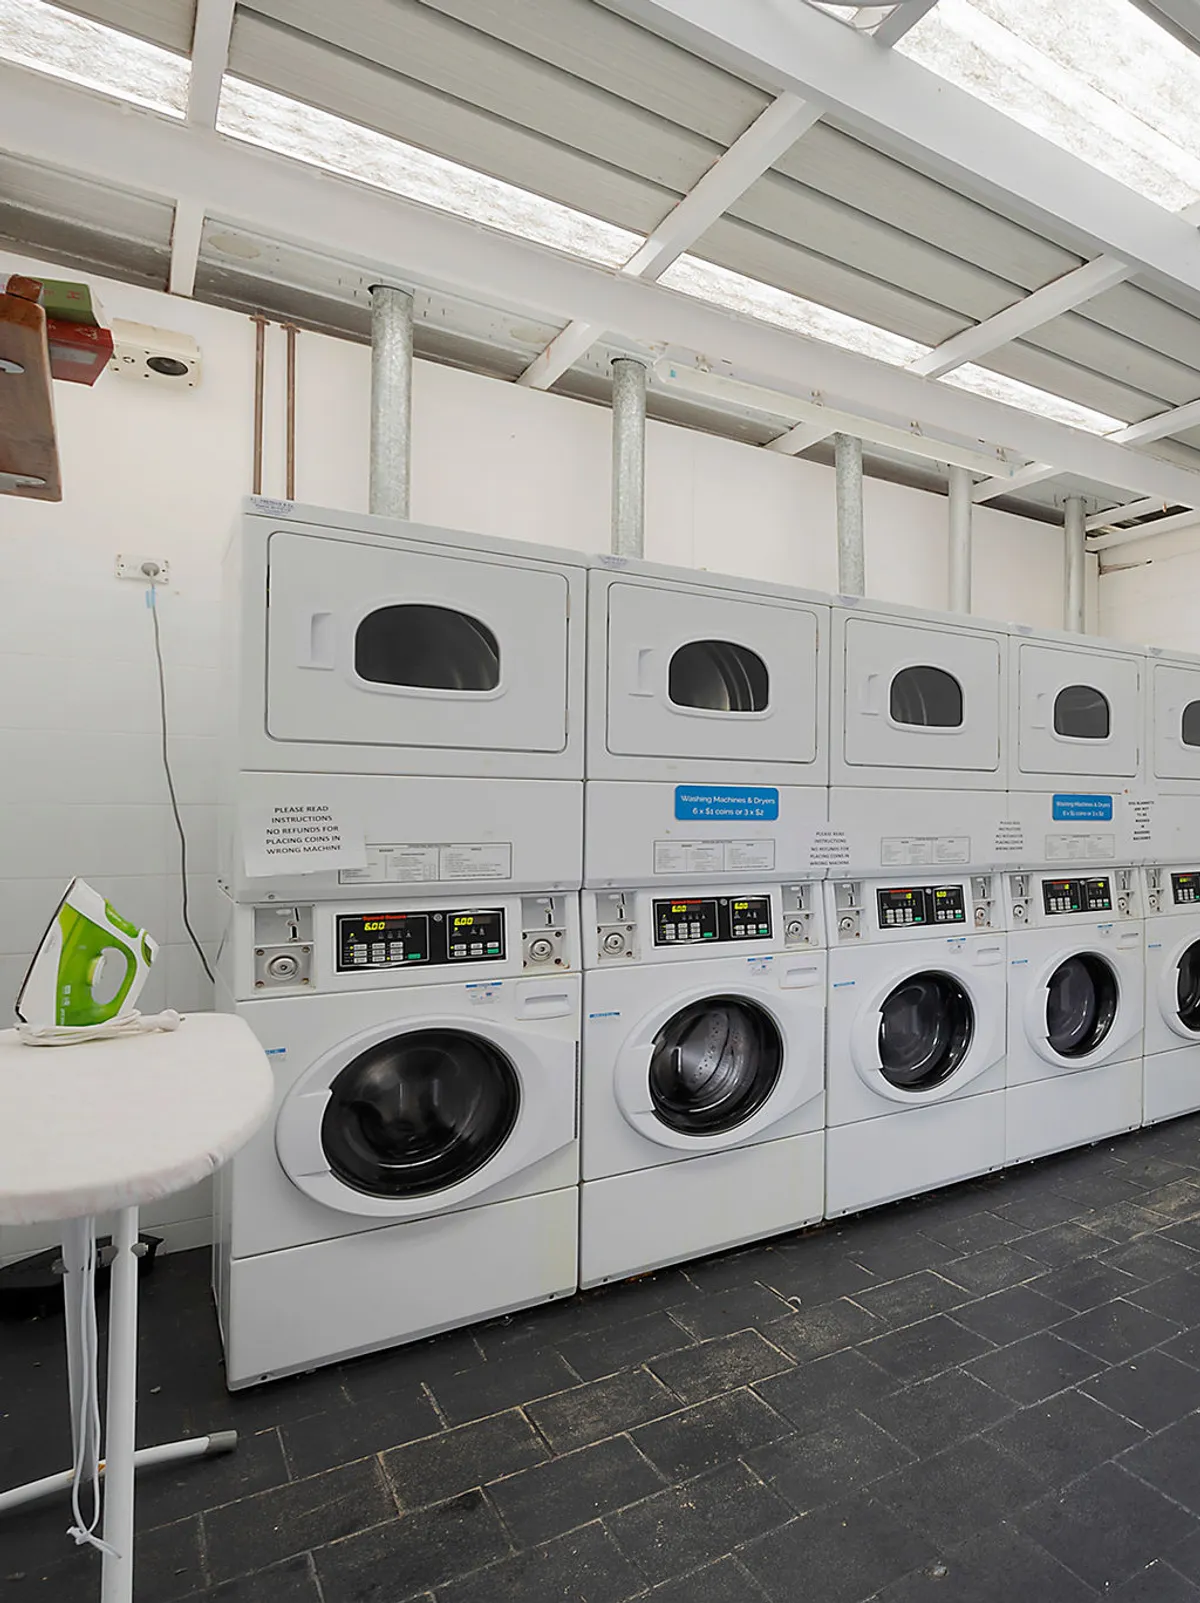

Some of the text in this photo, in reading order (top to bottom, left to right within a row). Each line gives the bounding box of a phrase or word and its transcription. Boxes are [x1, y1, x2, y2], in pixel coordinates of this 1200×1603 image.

[680, 795, 712, 804] Washing
[713, 796, 746, 804] Machines
[753, 797, 776, 806] Dryers
[692, 807, 698, 815] 6
[715, 808, 733, 816] coins
[735, 808, 743, 816] or
[744, 808, 749, 817] 3
[271, 815, 333, 823] INSTRUCTIONS
[282, 826, 320, 834] REFUNDS
